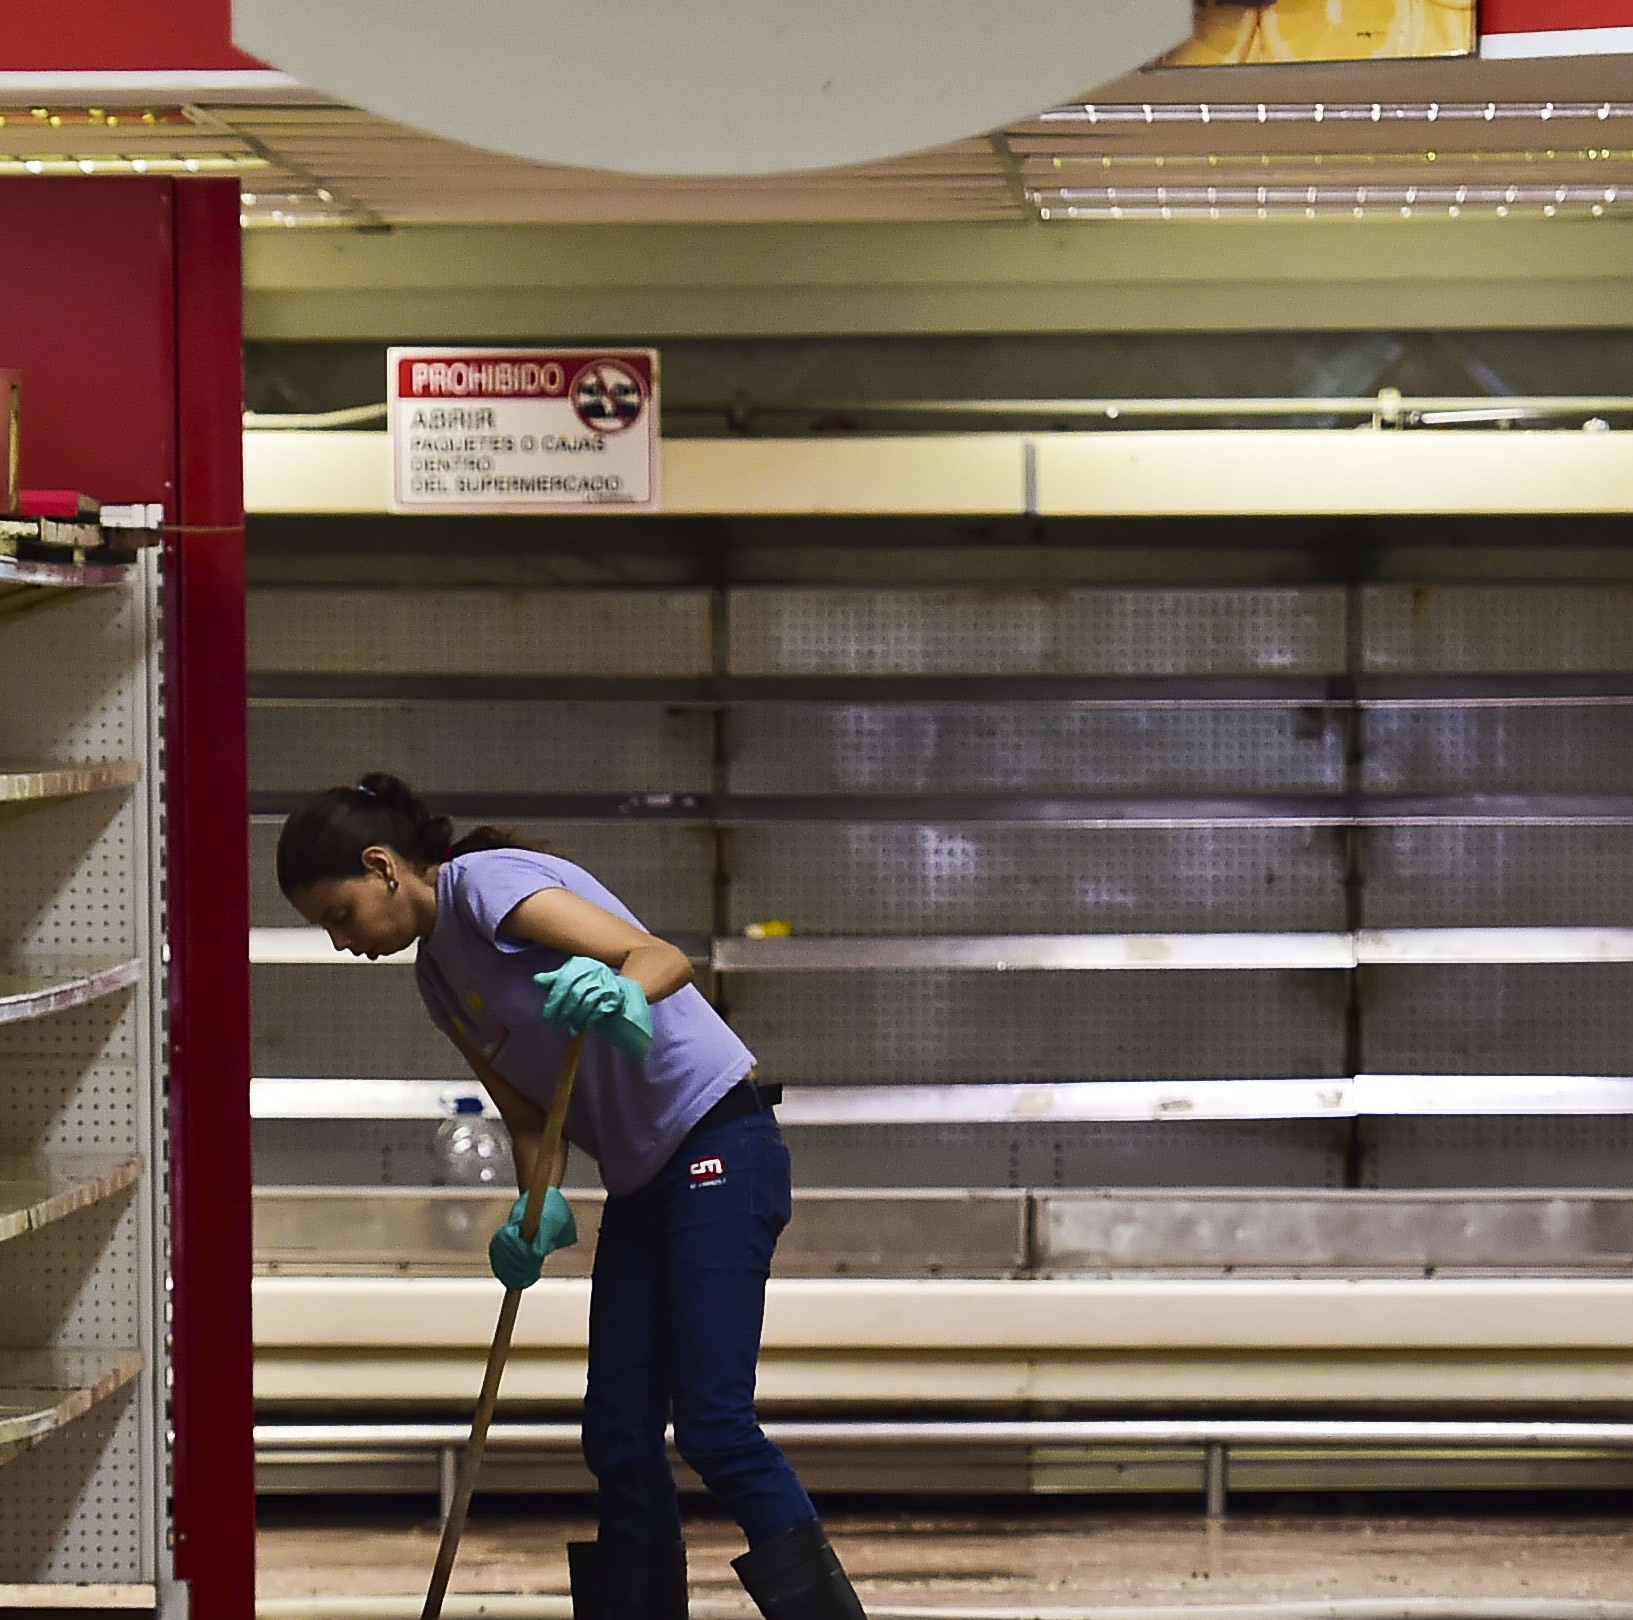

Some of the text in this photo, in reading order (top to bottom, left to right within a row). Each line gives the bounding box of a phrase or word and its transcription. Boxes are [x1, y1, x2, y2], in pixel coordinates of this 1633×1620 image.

[411, 362, 566, 396] PROHIBIDO
[410, 407, 497, 430] ABRIR
[410, 435, 514, 453] PAQUETES
[540, 435, 606, 453] CAJAS
[410, 456, 493, 473] DENTRO
[410, 475, 623, 494] DEL SUPERMERCADO
